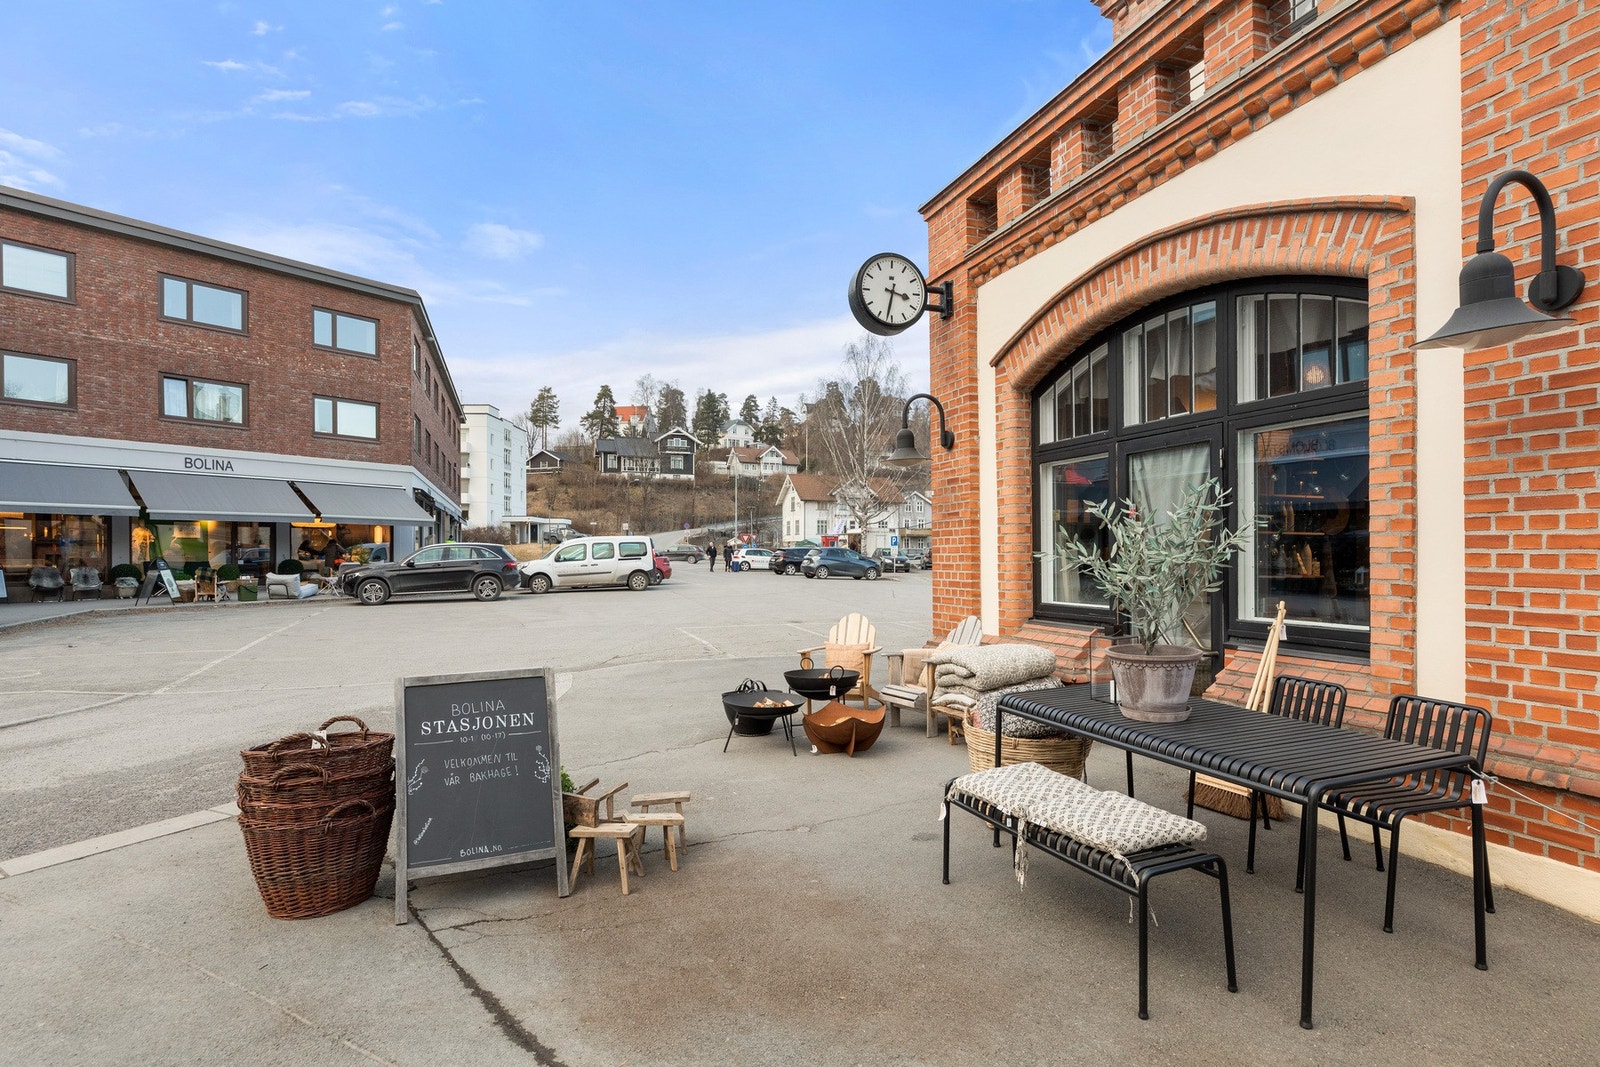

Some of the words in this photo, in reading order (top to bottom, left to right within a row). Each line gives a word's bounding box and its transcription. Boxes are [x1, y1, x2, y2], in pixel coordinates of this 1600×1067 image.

[184, 457, 234, 472] BOLINA
[451, 699, 506, 717] BOLINA
[420, 711, 535, 736] STASJONEN
[444, 753, 501, 768] VELKOMMEN
[505, 752, 519, 761] TIL
[444, 772, 461, 786] VÅR
[459, 844, 503, 857] BOLINA.NO
